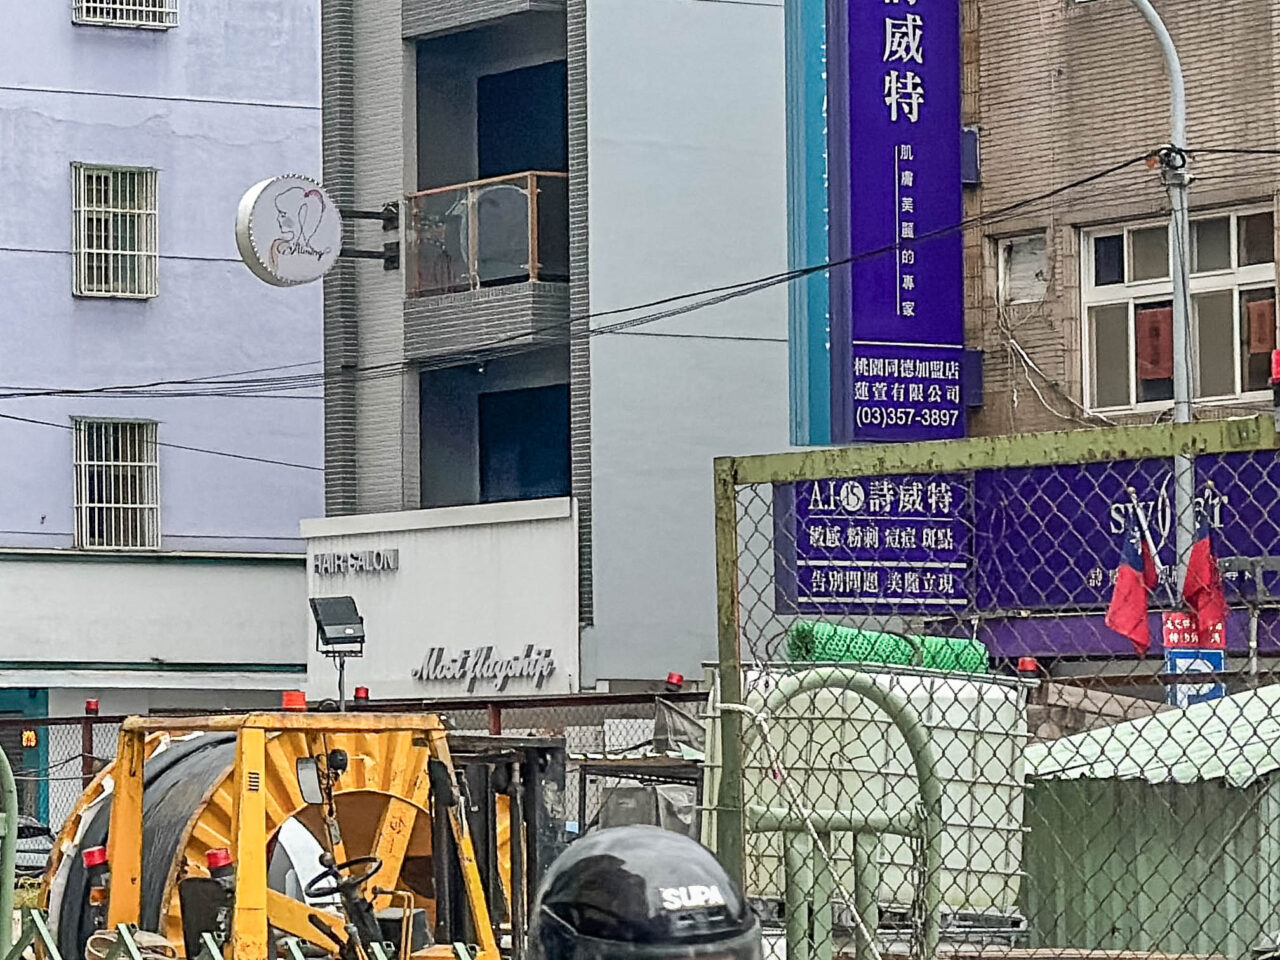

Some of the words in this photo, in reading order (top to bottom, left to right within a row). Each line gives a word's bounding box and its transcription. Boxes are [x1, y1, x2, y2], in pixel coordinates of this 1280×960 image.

[899, 144, 916, 318] 肌膚美麗的專家
[854, 357, 960, 380] 桃園同德加盟店
[856, 406, 959, 428] (03)357-3897
[870, 481, 953, 513] 詩威特
[810, 525, 841, 548] 敏感
[847, 526, 879, 548] 粉刺
[884, 527, 917, 548] 痘痘
[922, 527, 954, 550] 斑點
[313, 552, 345, 574] HAIR
[347, 548, 396, 571] SALON
[811, 570, 879, 593] 告別問題
[887, 571, 955, 594] 美麗立現
[411, 646, 469, 681] Most
